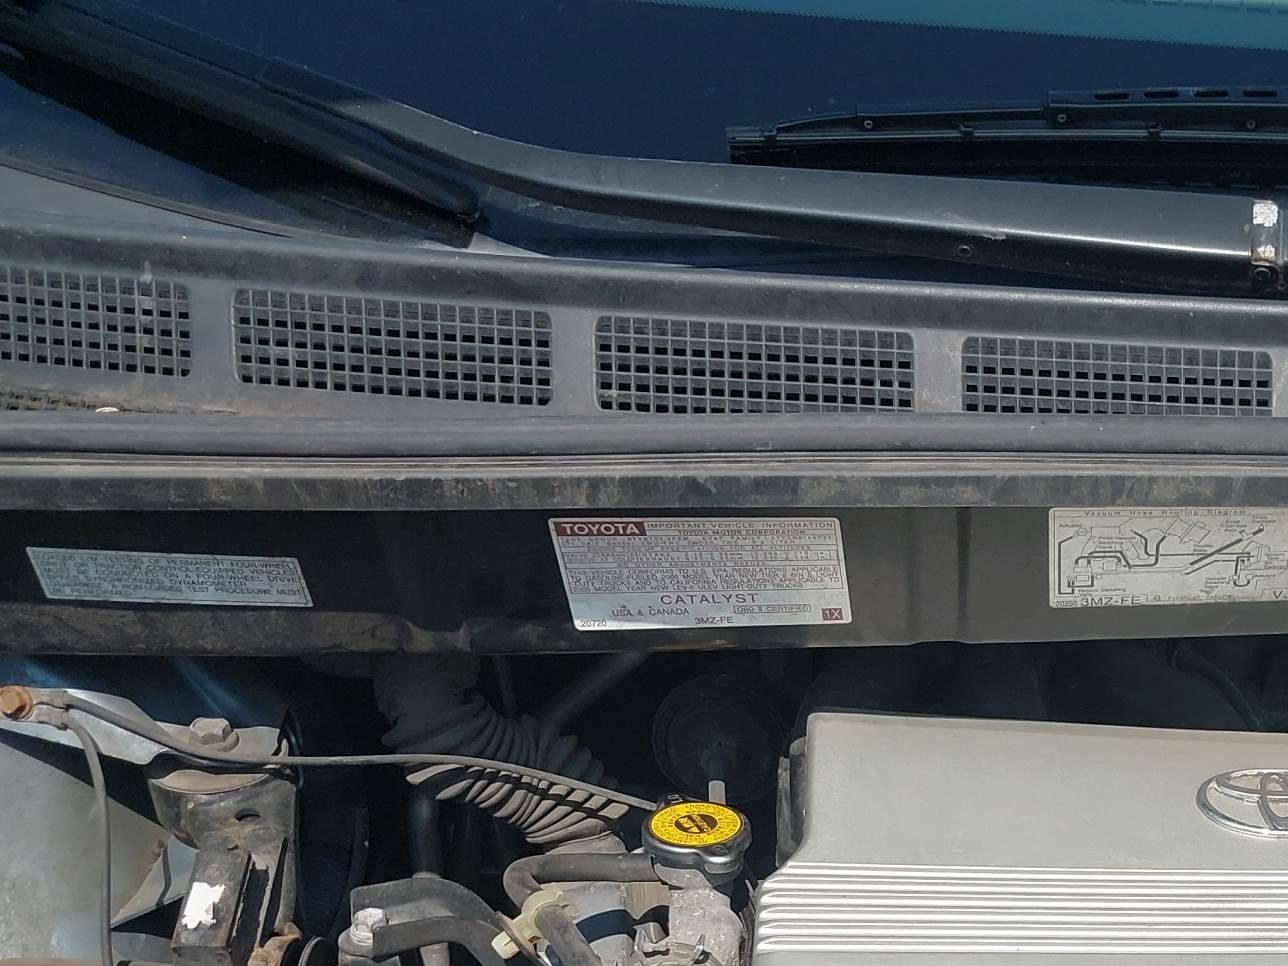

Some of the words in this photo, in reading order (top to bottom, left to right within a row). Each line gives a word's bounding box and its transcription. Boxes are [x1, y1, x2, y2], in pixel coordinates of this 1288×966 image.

[561, 523, 641, 536] TOYOTA
[762, 521, 833, 529] INFORMATION
[267, 576, 299, 584] DRIVE
[660, 593, 759, 605] CATALYST
[1080, 596, 1142, 607] 3MZ-FE
[612, 607, 634, 617] USA
[649, 607, 690, 617] CANADA
[824, 609, 843, 621] 1X
[580, 619, 608, 628] 20720
[694, 616, 735, 625] 3MZ-FE
